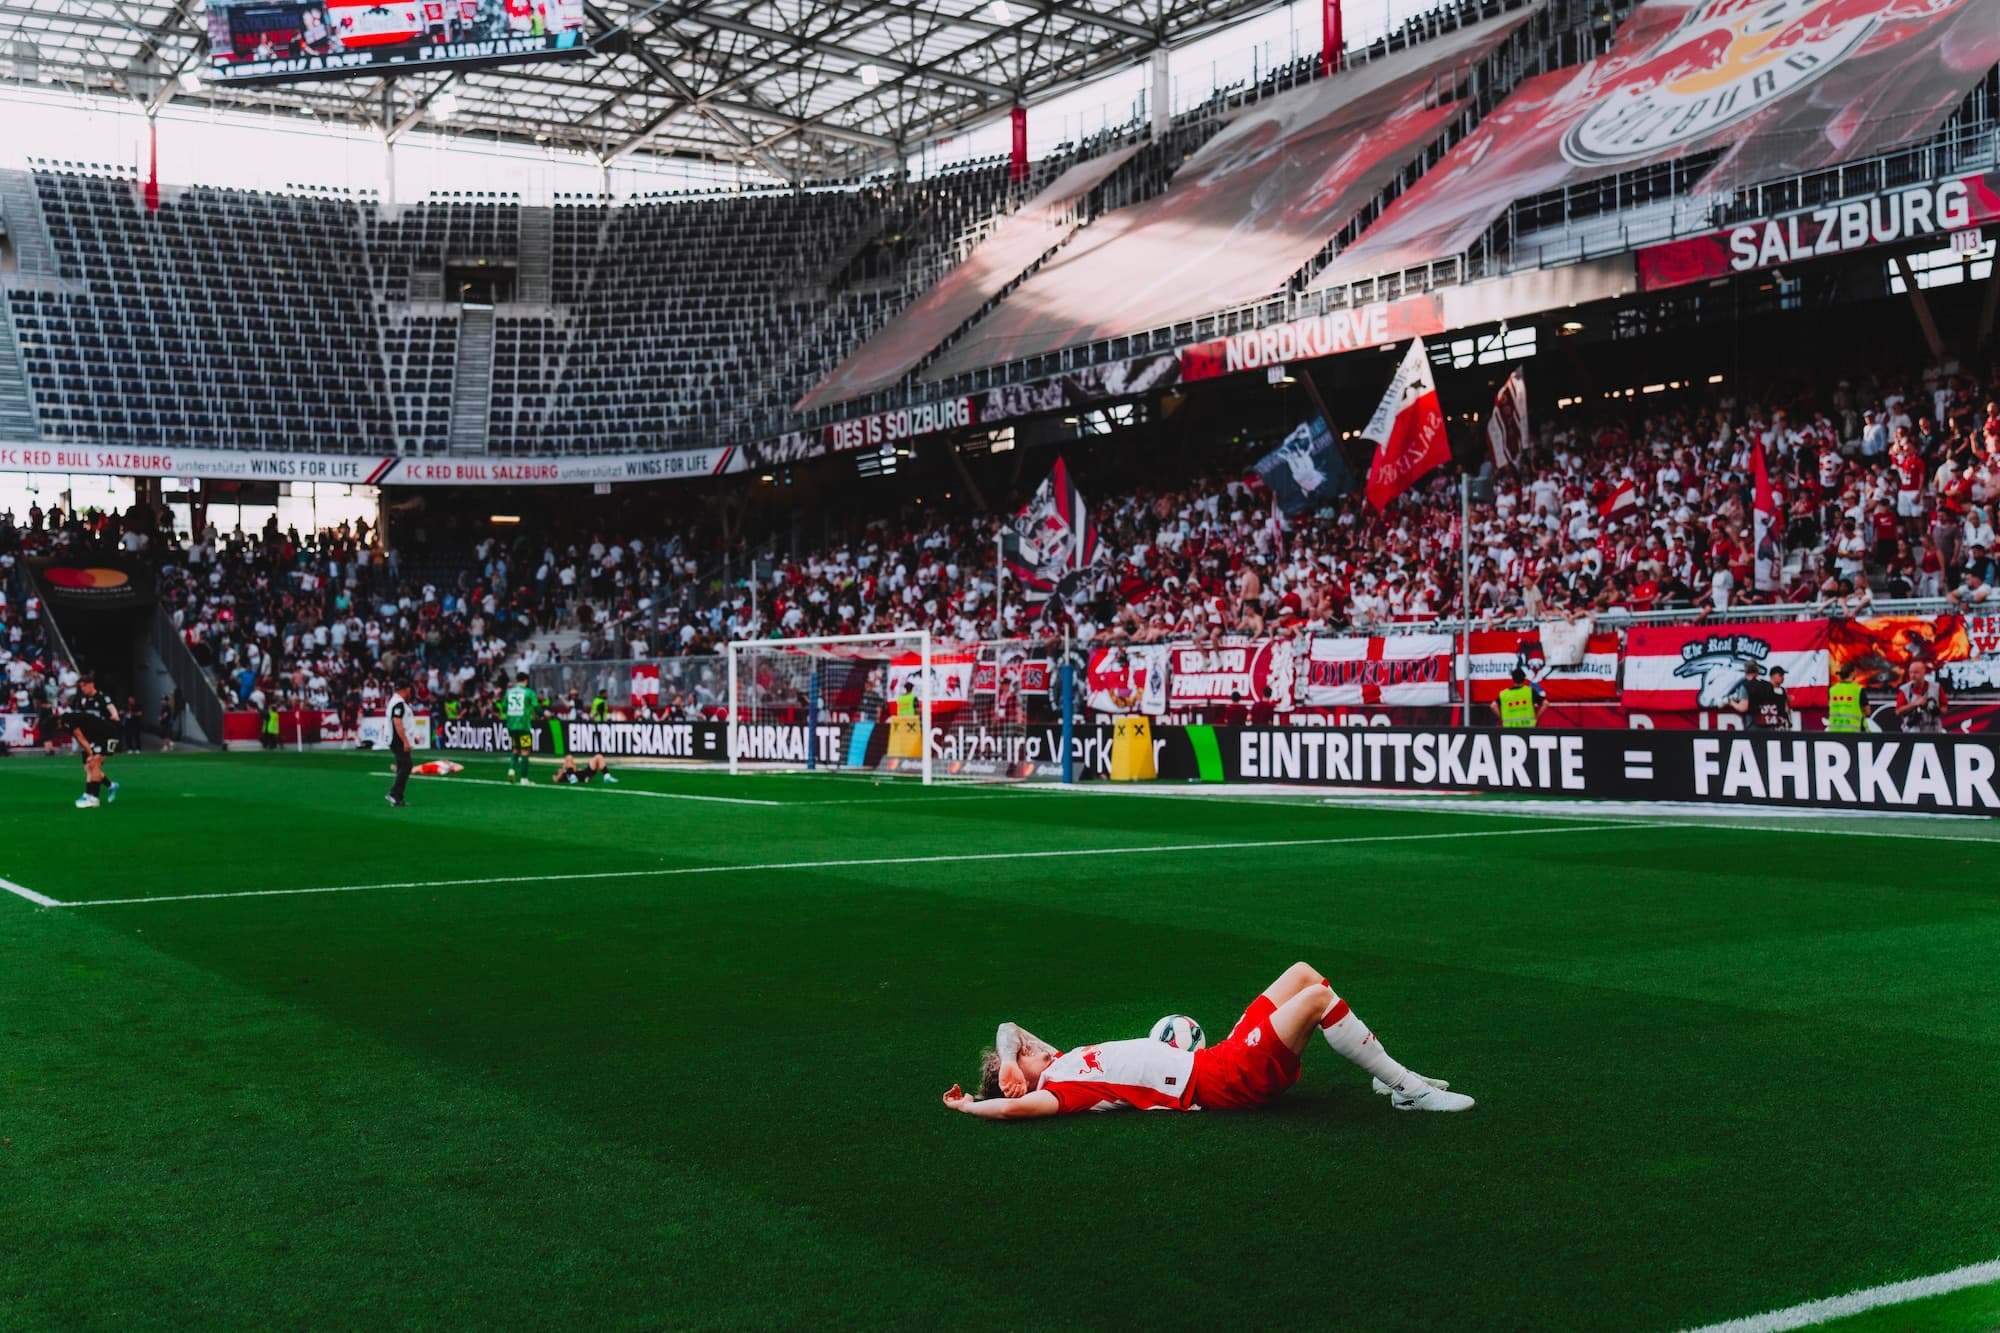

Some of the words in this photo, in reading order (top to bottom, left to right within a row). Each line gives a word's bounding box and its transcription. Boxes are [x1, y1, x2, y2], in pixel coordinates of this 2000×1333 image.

[1729, 181, 1970, 271] SALZBURG
[1954, 231, 1977, 251] 113
[1226, 307, 1389, 372] NORDKURVE
[832, 422, 863, 451] DES
[866, 418, 882, 444] IS
[1, 450, 17, 465] FC
[24, 450, 51, 466] RED
[58, 451, 90, 467] BULL
[97, 453, 173, 471] SALZBURG
[250, 458, 296, 475] WINGS
[300, 461, 327, 476] FOR
[331, 462, 359, 478] LIFE
[407, 464, 422, 479] FC
[426, 464, 452, 480] RED
[456, 465, 488, 480] BULL
[492, 464, 558, 480] SALZBURG
[626, 460, 662, 476] WINGS
[664, 457, 685, 473] FOR
[687, 455, 708, 471] LIFE
[1972, 616, 2000, 633] RE
[1683, 643, 1703, 660] The
[1708, 637, 1733, 652] Real
[508, 696, 525, 713] 53
[444, 720, 493, 752] Salzburg
[568, 723, 694, 756] EINTRITTSKARTE
[727, 724, 841, 761] AHRKATE
[931, 724, 1041, 763] Salzburg
[1239, 731, 1586, 790] EINTRITTSKARTE
[1624, 750, 1654, 779] =
[1692, 738, 2000, 808] FAHRKAR
